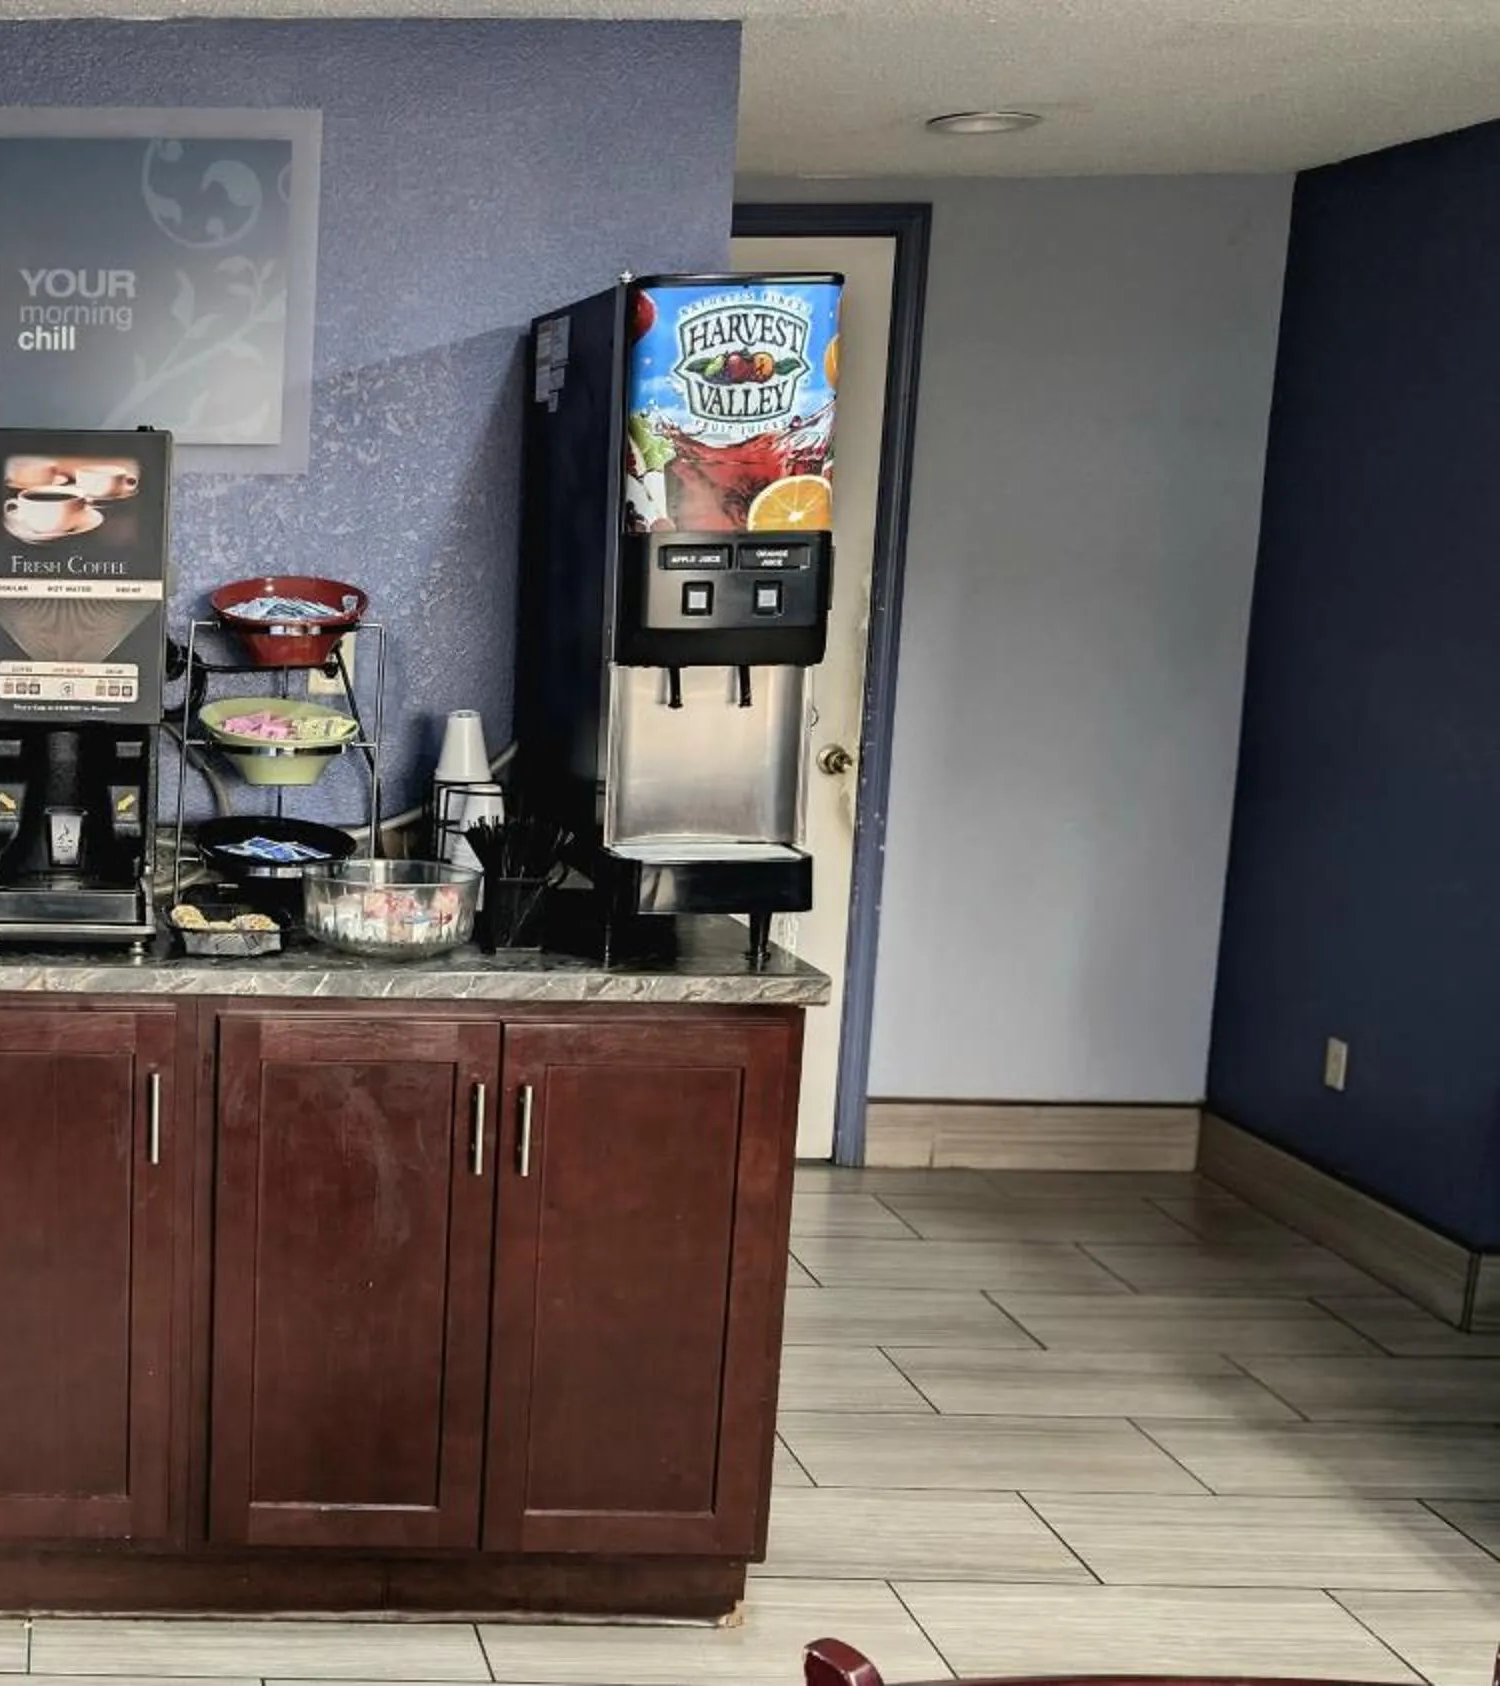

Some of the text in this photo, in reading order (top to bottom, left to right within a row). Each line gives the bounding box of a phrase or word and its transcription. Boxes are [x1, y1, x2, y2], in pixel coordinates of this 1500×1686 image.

[18, 268, 137, 299] YOUR
[19, 302, 133, 332] morning
[17, 325, 76, 351] chill
[688, 313, 804, 354] HARVEST
[695, 379, 790, 417] VALLEY
[10, 554, 128, 575] FRESH COFFEE
